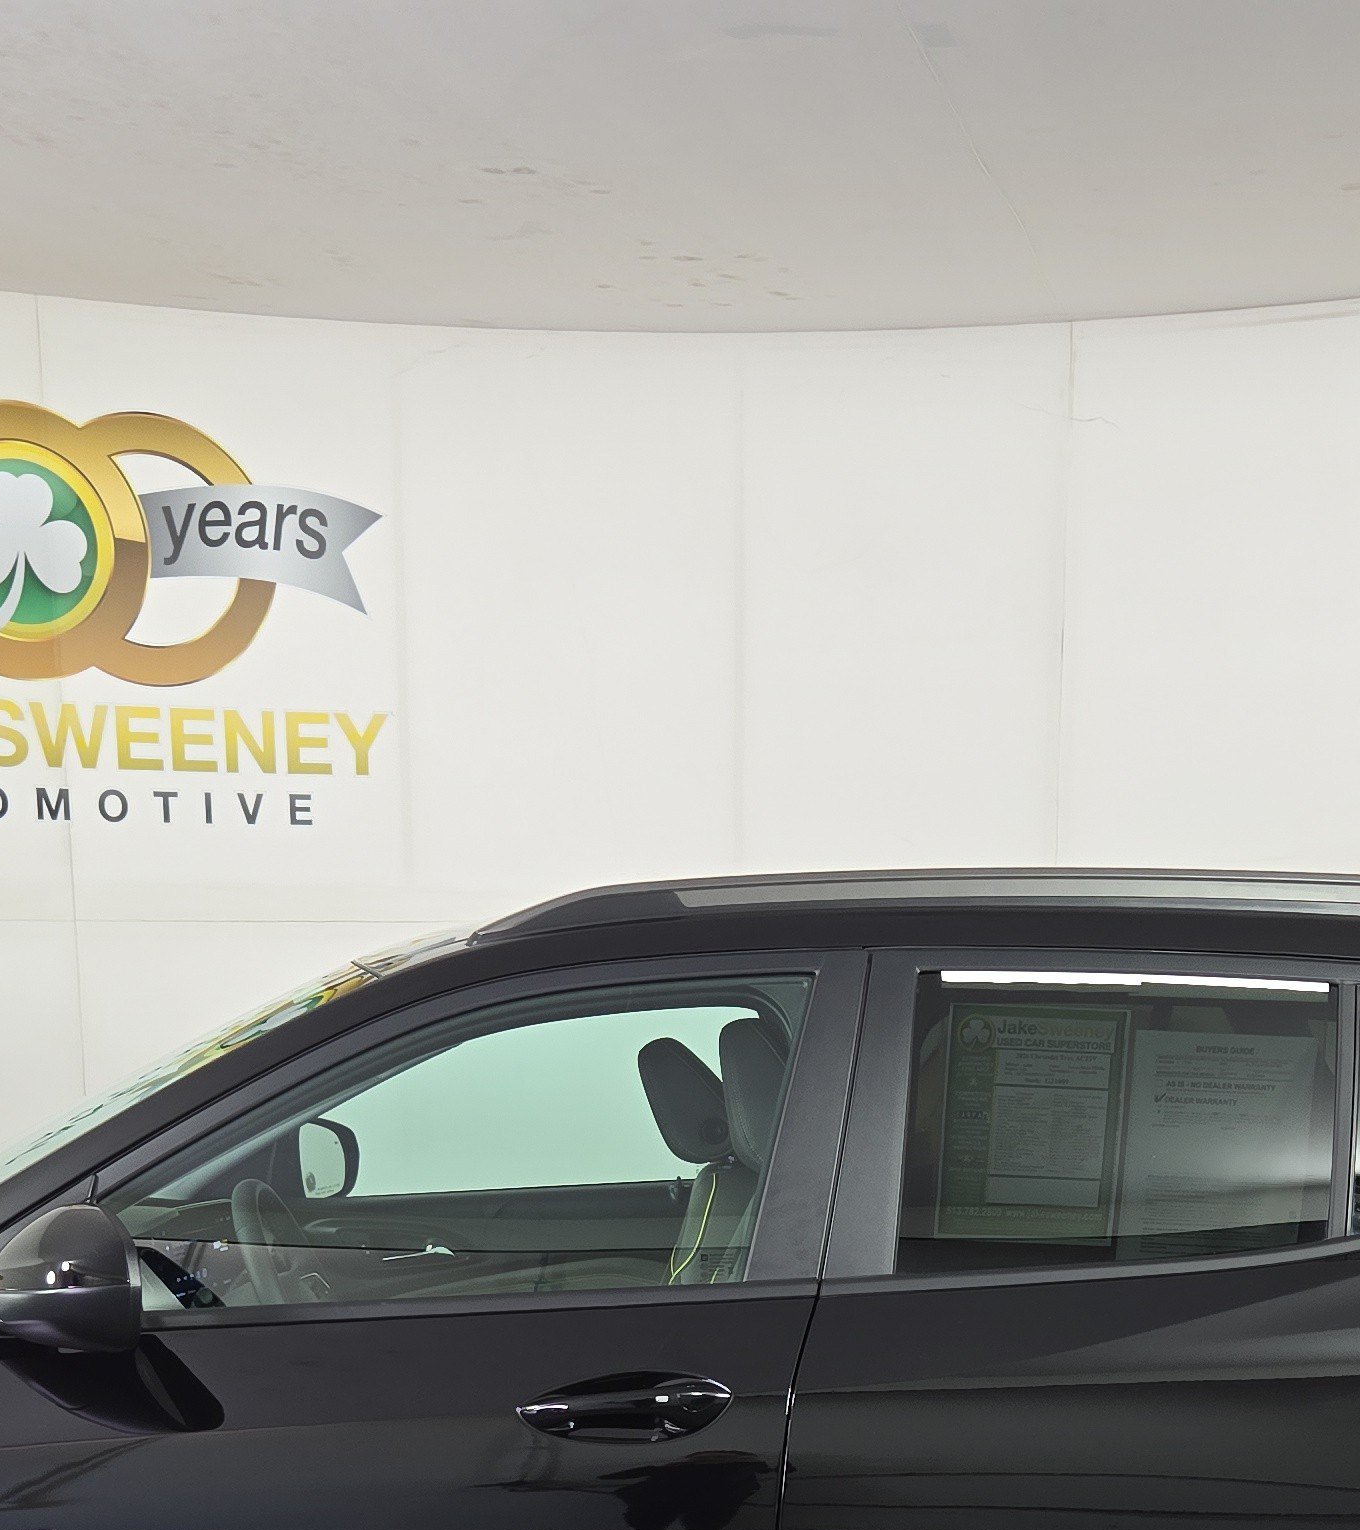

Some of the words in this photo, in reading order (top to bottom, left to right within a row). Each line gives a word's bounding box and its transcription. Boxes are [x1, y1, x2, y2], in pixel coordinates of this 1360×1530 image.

[162, 499, 329, 566] years
[997, 1019, 1038, 1035] Jake
[997, 1038, 1023, 1047] USED
[1024, 1038, 1046, 1048] CAR
[1047, 1040, 1112, 1051] SUPERSTORE
[1203, 1082, 1232, 1090] DEALER
